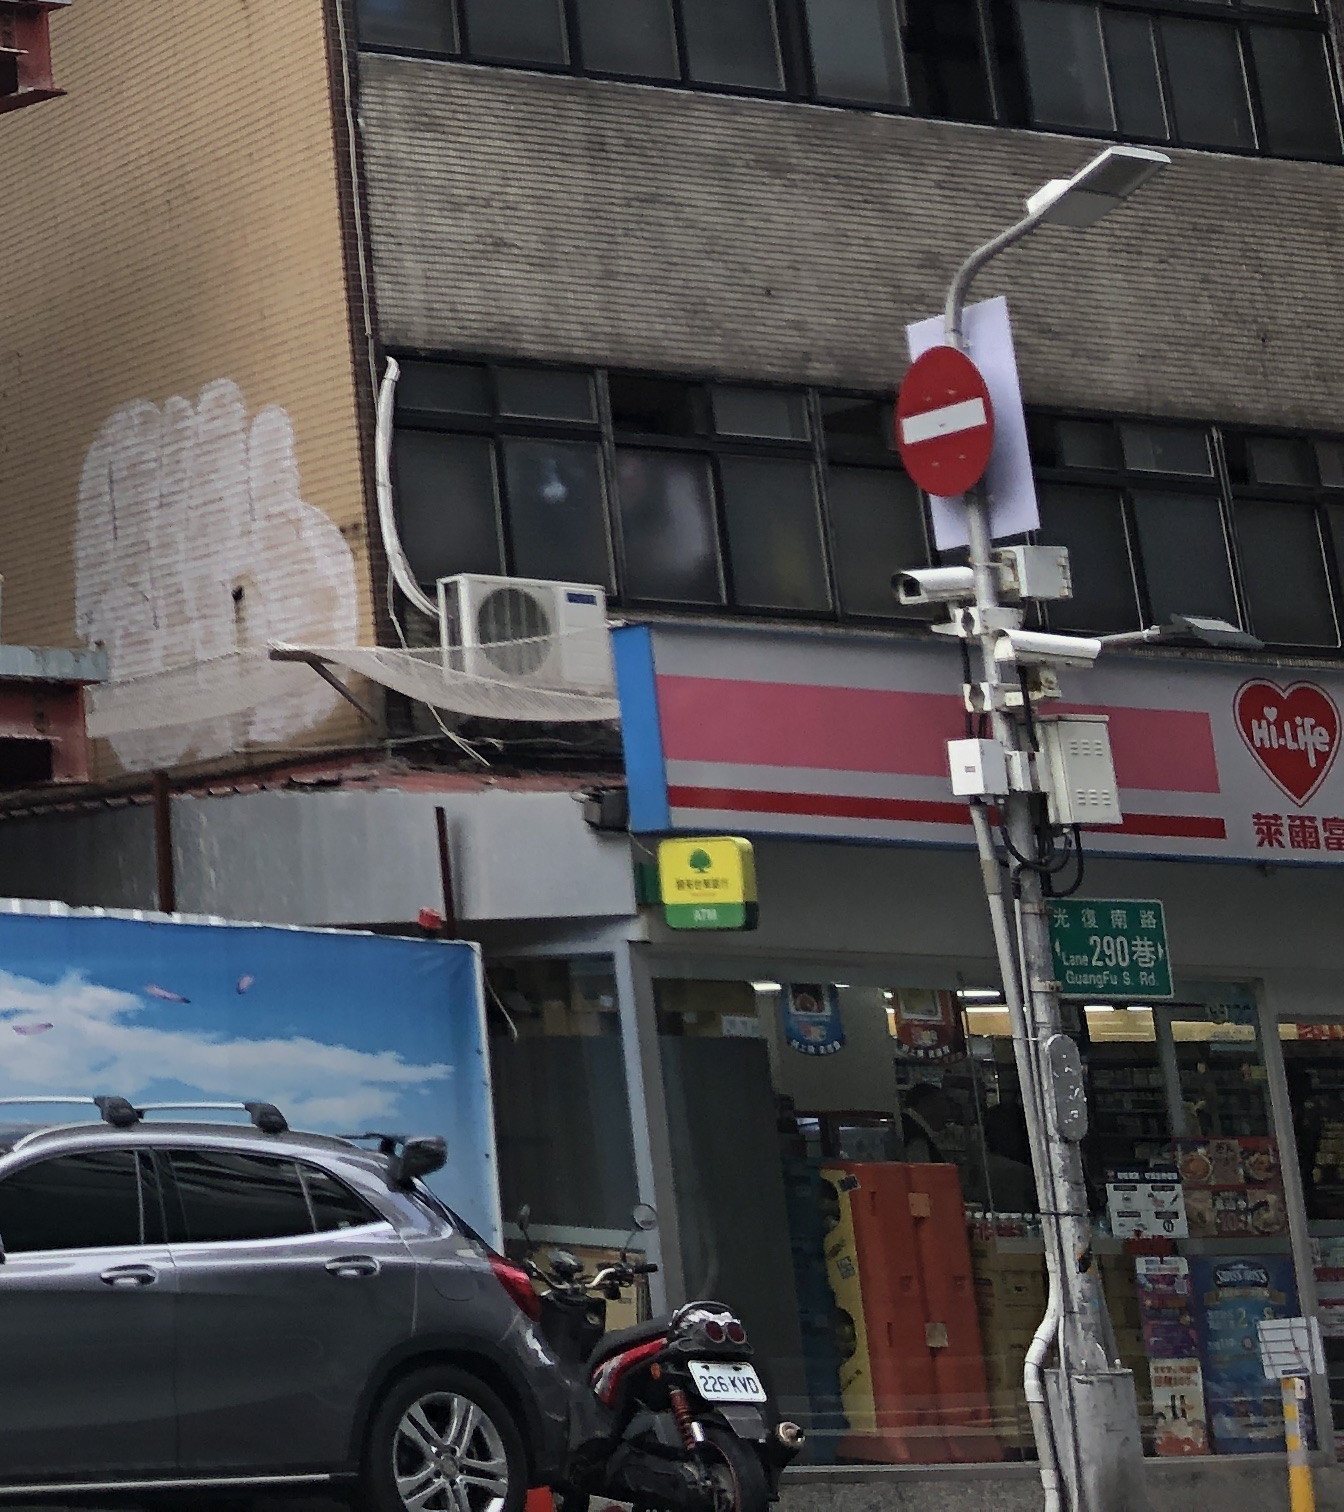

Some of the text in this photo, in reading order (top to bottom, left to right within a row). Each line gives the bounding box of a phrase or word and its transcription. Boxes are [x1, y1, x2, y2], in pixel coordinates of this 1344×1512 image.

[693, 909, 718, 921] ATM
[1053, 907, 1157, 929] 光復南路
[1062, 935, 1157, 968] Lane 290巷
[1065, 970, 1159, 988] GuangFu S. Rd.
